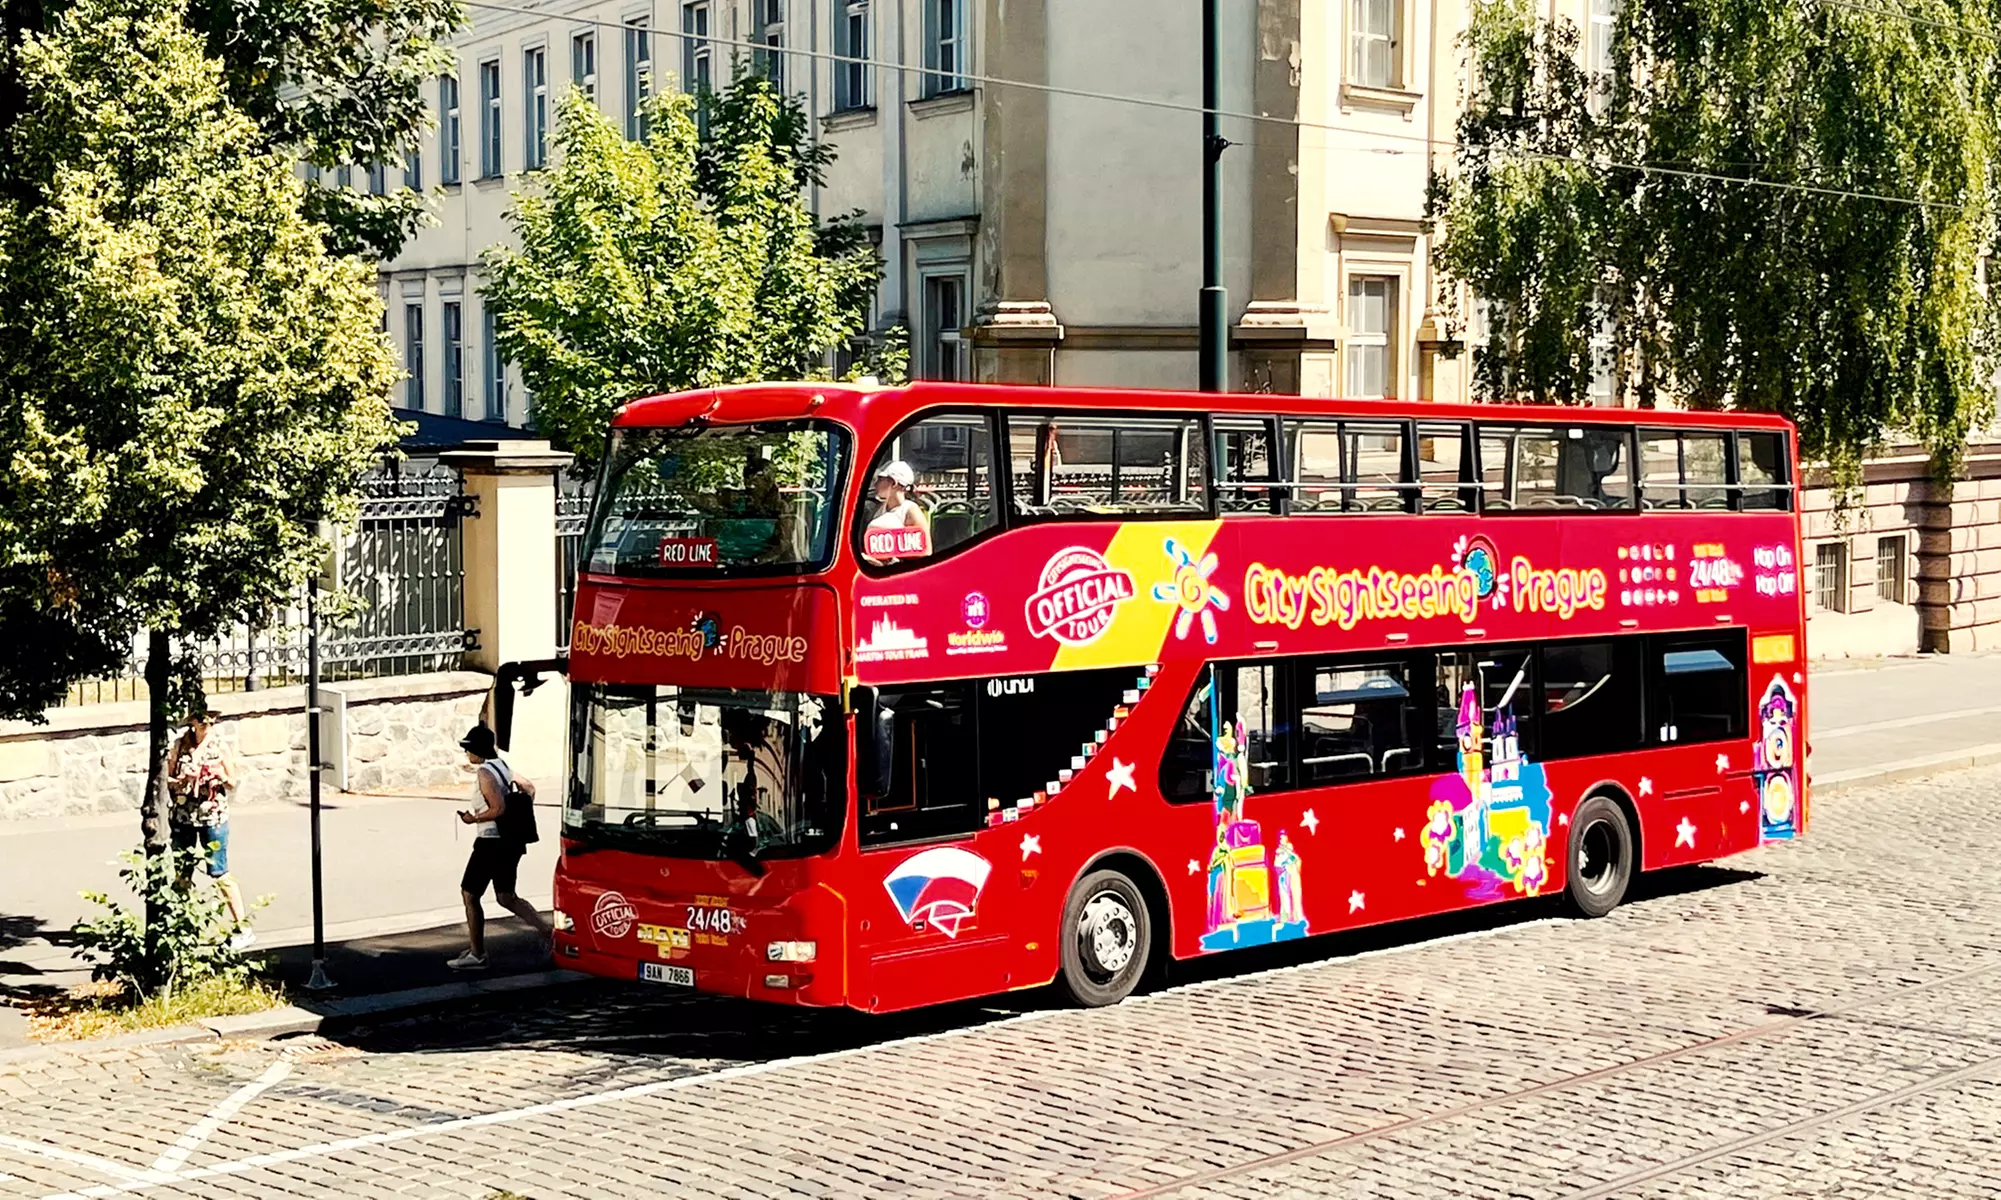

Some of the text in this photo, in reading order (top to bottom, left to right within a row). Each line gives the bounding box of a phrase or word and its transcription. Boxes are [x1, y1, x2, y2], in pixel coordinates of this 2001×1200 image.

[664, 543, 712, 563] RED LINE
[869, 531, 923, 553] RED LINE
[1753, 545, 1792, 569] Hop On
[1511, 555, 1608, 620] Prague
[1755, 572, 1796, 597] Hop Off
[860, 595, 905, 607] OPERATED
[1037, 574, 1130, 627] OFFICIAL
[1068, 608, 1110, 639] TOUR
[730, 625, 808, 667] Prague
[596, 906, 636, 928] OFFICIAL
[610, 922, 628, 935] TOUR
[687, 906, 731, 933] 24/48
[646, 965, 690, 984] 9AN 7866
